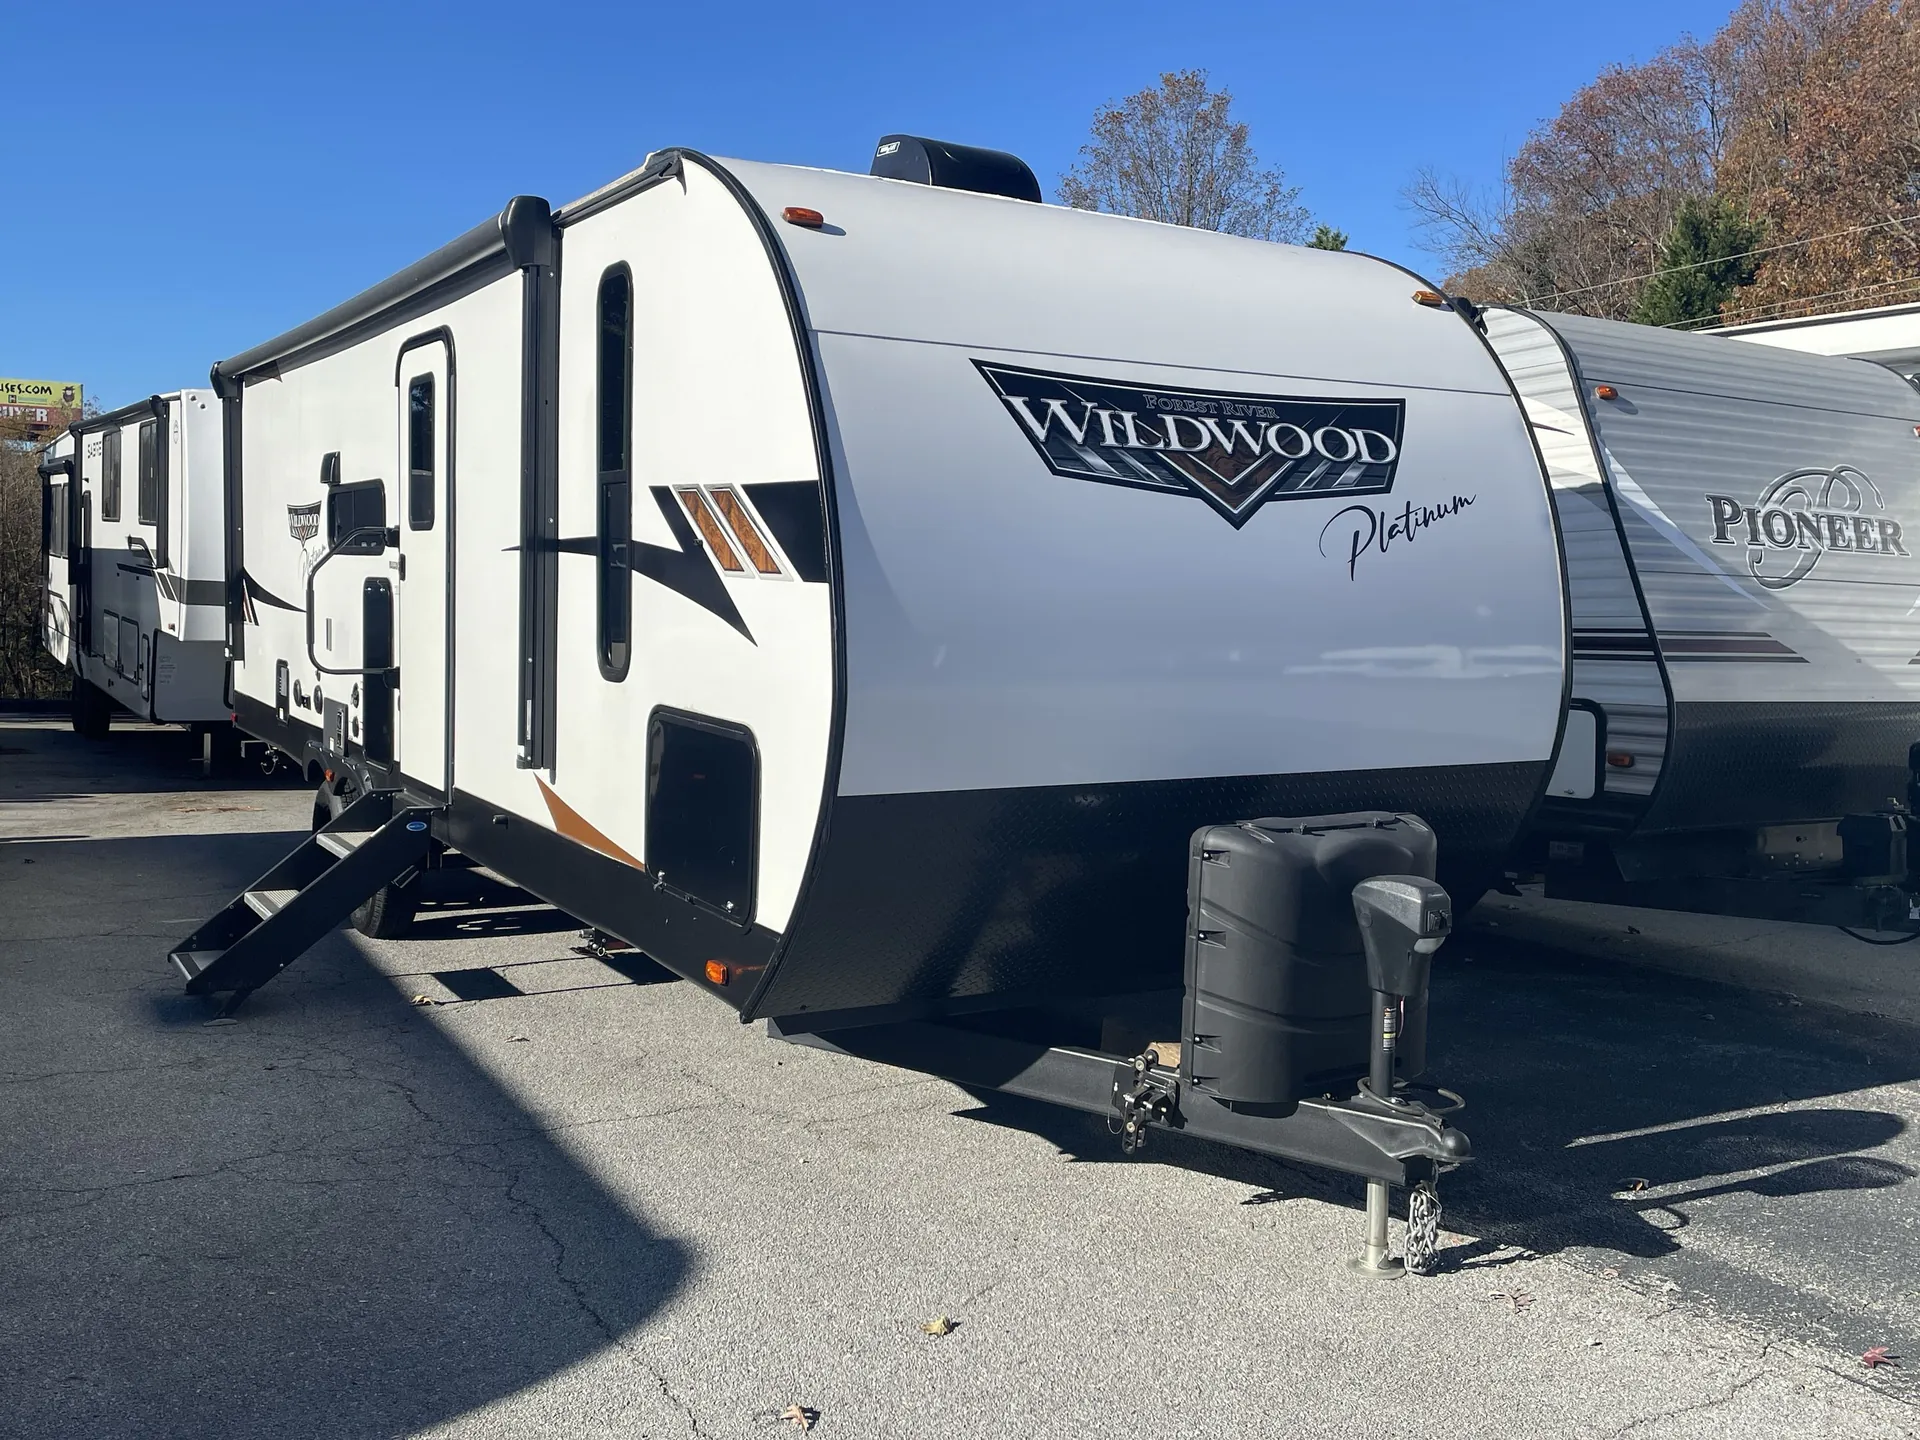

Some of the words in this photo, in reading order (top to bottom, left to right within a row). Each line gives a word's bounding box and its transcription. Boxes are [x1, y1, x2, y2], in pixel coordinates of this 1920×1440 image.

[1002, 395, 1397, 464] WILDWOOD
[1143, 394, 1219, 414] FOREST
[1221, 402, 1280, 420] RIVER
[288, 513, 321, 527] WILDWOOD
[1318, 494, 1477, 582] Platinum
[1705, 493, 1911, 558] PIONEER
